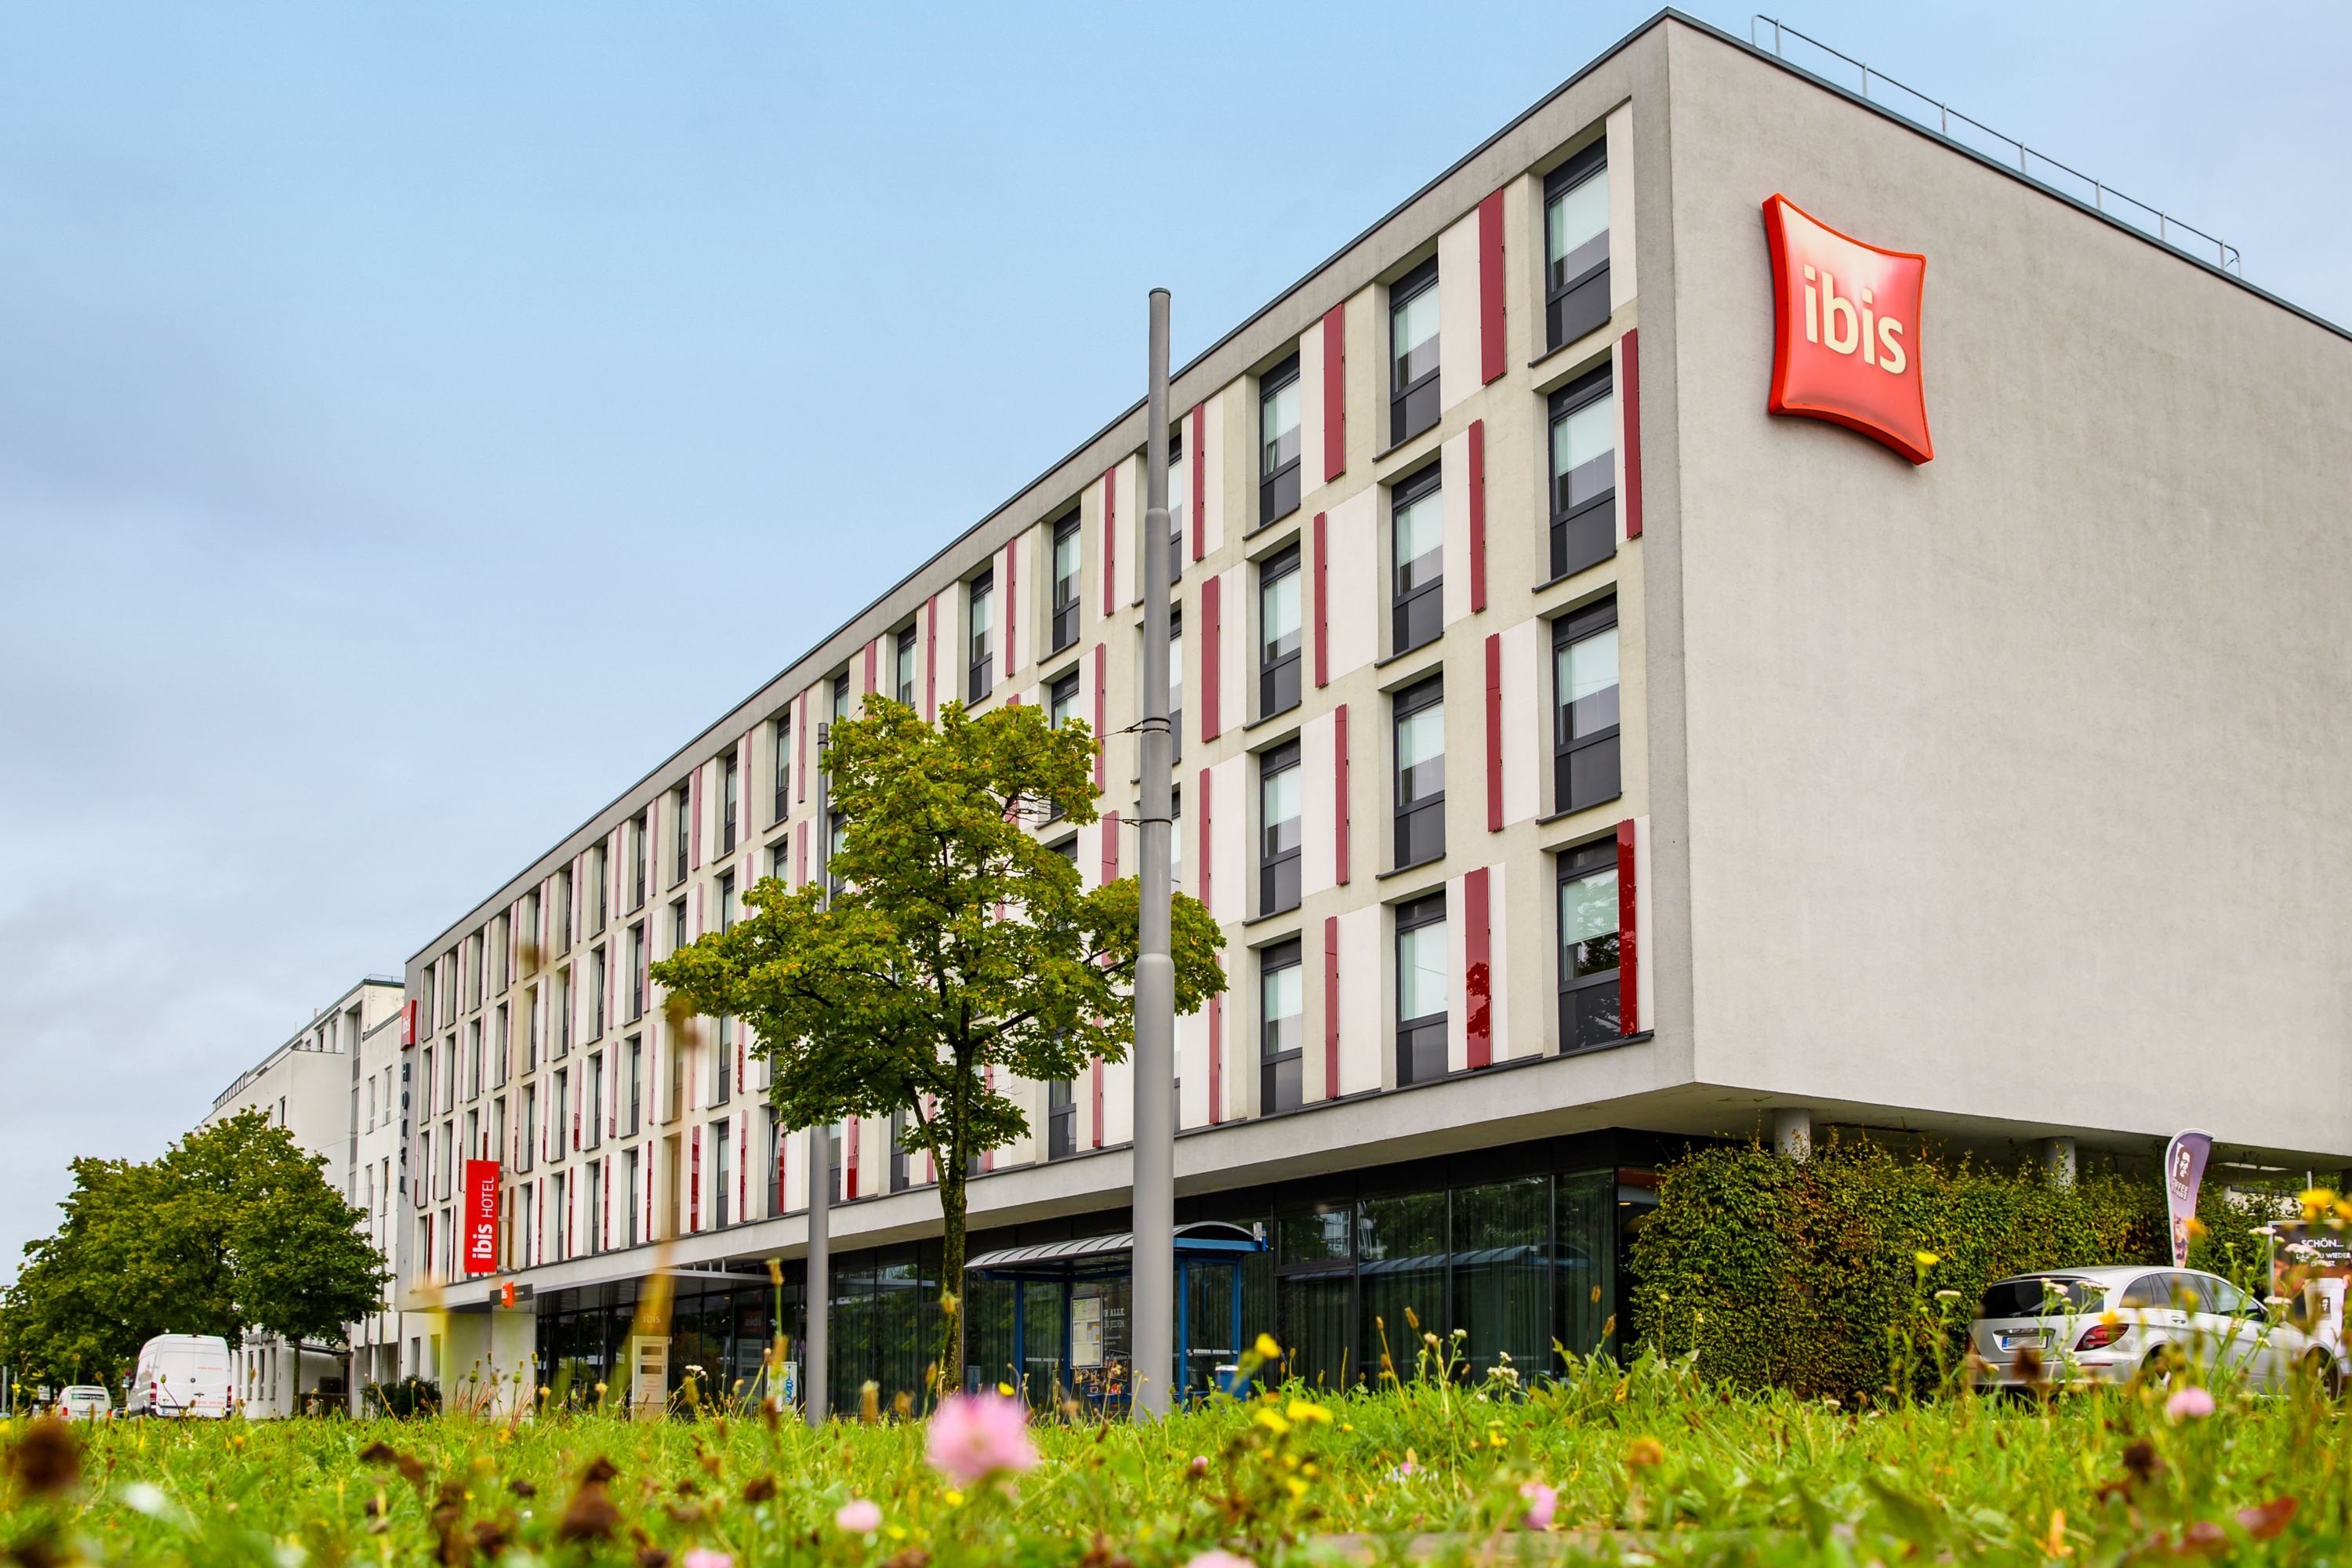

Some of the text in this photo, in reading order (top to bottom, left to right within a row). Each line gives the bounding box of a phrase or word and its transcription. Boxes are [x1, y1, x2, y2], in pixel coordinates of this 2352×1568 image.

[1804, 263, 1907, 374] ibis
[472, 1176, 494, 1259] ibis HOTEL
